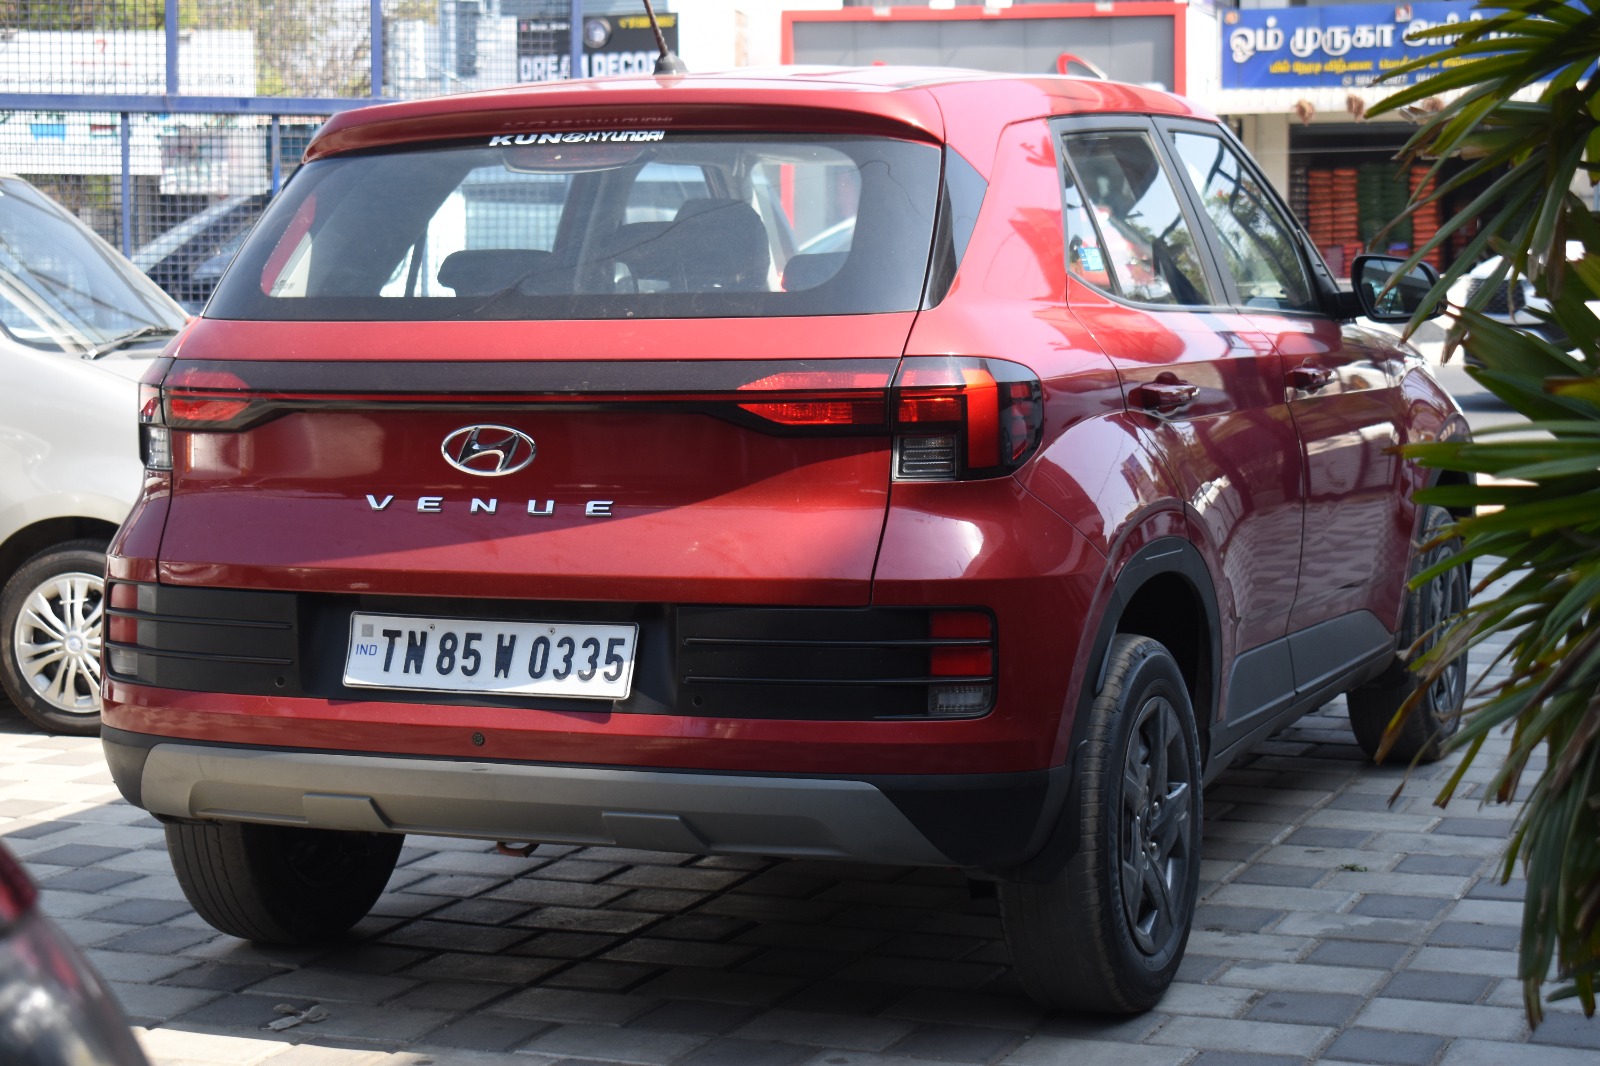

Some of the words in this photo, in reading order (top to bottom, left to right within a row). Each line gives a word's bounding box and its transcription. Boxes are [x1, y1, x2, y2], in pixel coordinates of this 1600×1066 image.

[1290, 24, 1395, 58] முருகா
[519, 53, 590, 82] DREA
[489, 132, 563, 146] KUN
[585, 130, 665, 143] HYUNDAI
[366, 494, 614, 517] VENUE
[355, 643, 378, 656] IND
[383, 629, 428, 675] TN
[435, 632, 483, 677] 85
[494, 633, 517, 679] W
[528, 635, 626, 682] 0335
